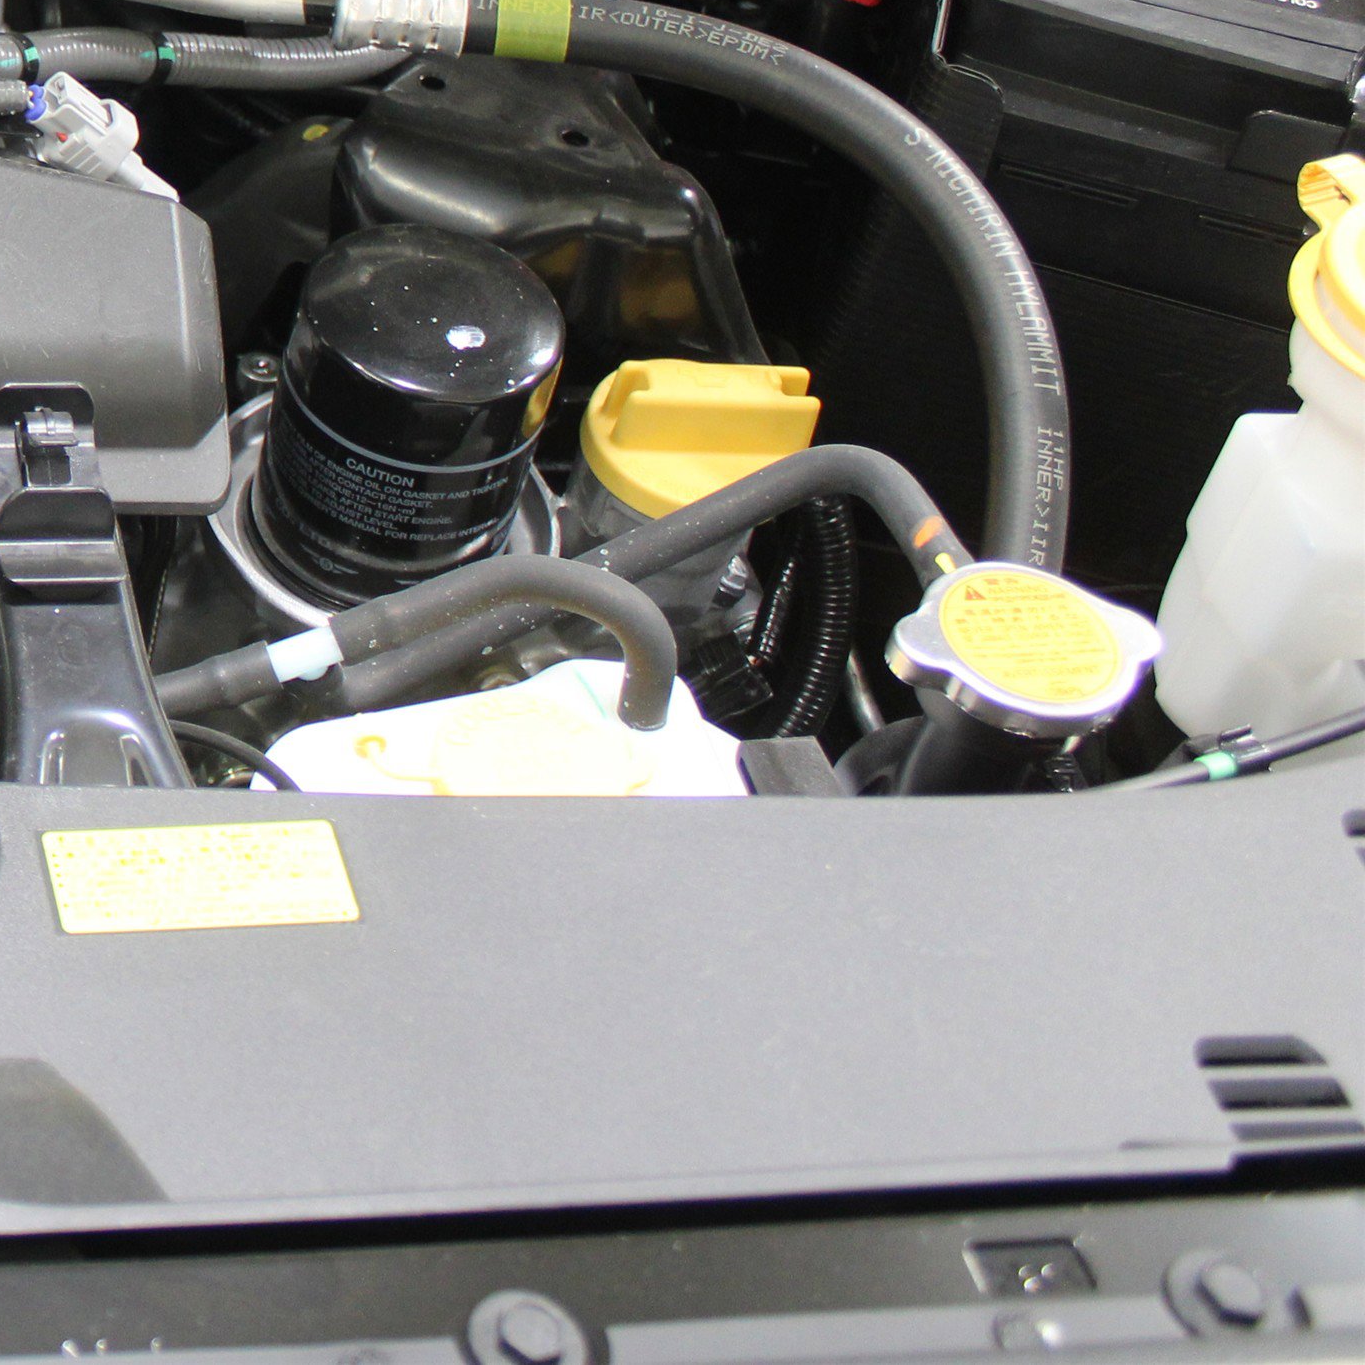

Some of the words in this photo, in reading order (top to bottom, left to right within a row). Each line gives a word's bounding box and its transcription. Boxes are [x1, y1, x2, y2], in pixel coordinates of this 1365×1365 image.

[1004, 270, 1061, 396] HYLAMMIT
[327, 460, 363, 484] ENGINE
[364, 480, 382, 492] OIL
[383, 486, 401, 495] ON
[402, 489, 445, 501] GASKET
[447, 490, 470, 500] AND
[346, 457, 415, 488] CAUTION
[337, 476, 387, 501] CONTACT
[387, 496, 433, 508] GASKET.
[324, 497, 362, 519] ADJUST
[363, 516, 399, 530] LEVEL.
[339, 496, 372, 515] AFTER
[373, 509, 410, 524] START
[411, 516, 453, 525] ENGINE.
[338, 514, 382, 535] MANUAL
[383, 527, 408, 540] FOR
[409, 531, 457, 542] REPLACE
